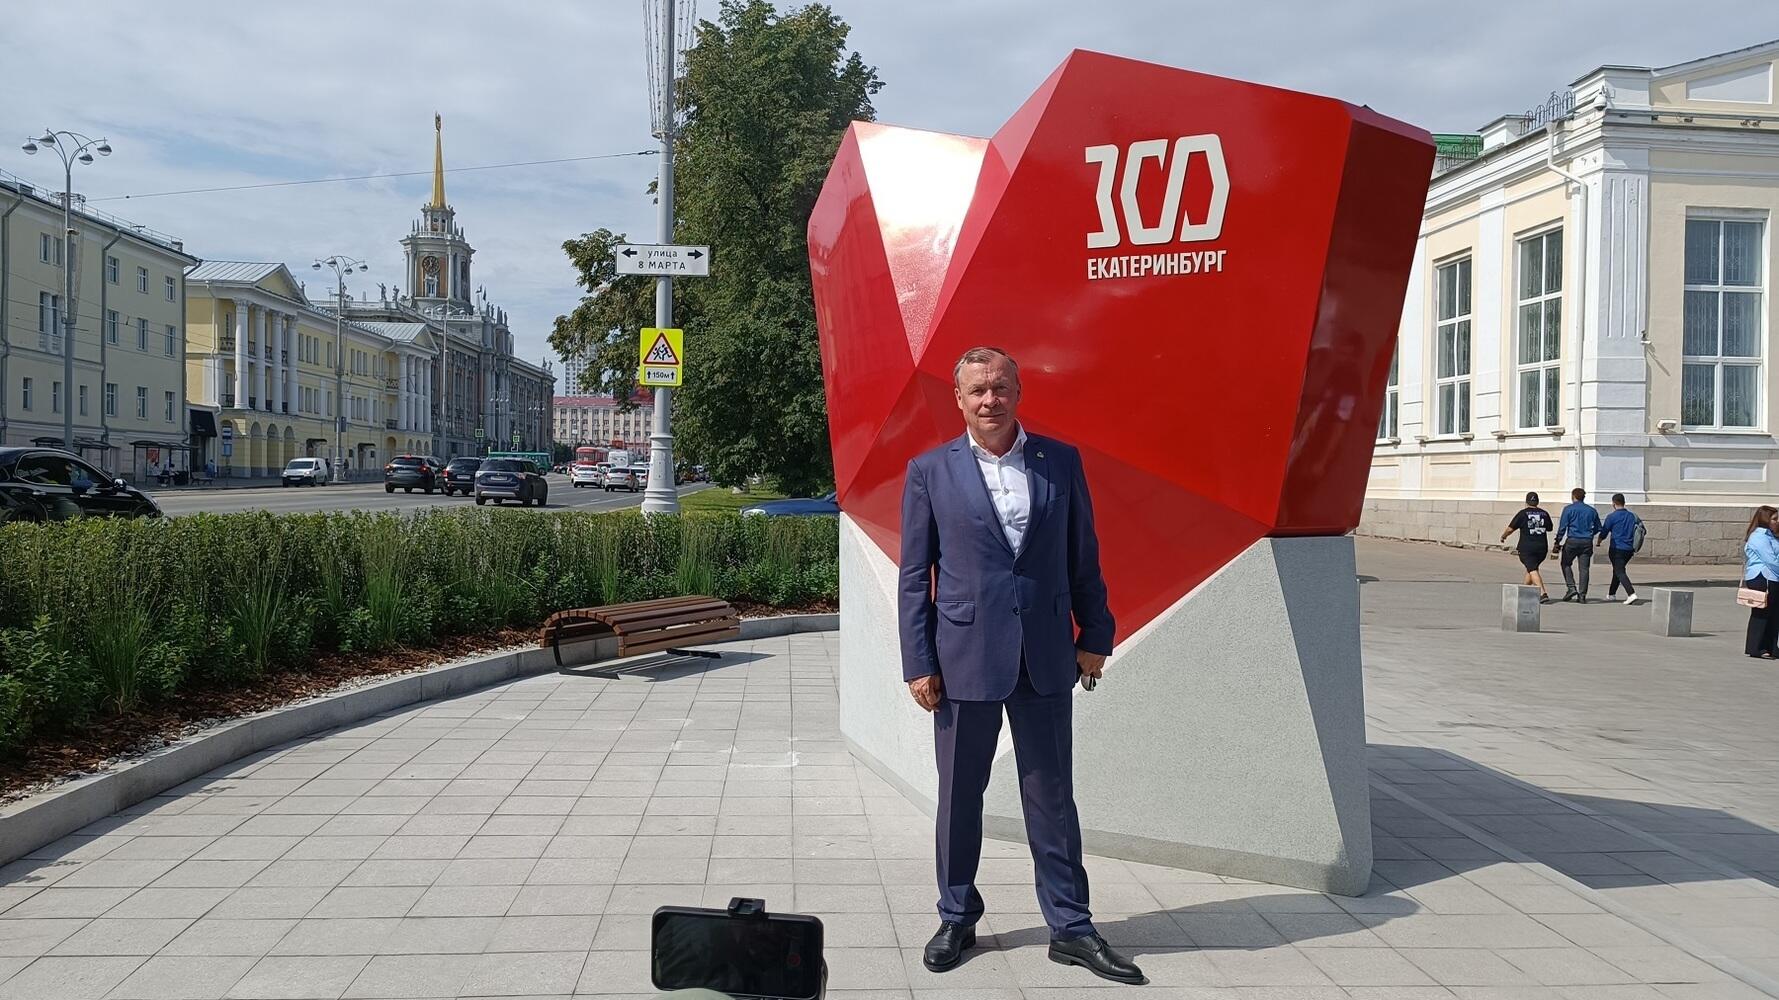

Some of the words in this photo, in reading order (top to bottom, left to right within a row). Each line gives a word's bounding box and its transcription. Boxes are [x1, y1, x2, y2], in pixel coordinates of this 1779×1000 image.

[648, 250, 678, 259] улица
[638, 261, 644, 269] 8
[648, 262, 686, 270] МАРТА
[1087, 250, 1227, 280] ЕКАТЕРИНБУРГ
